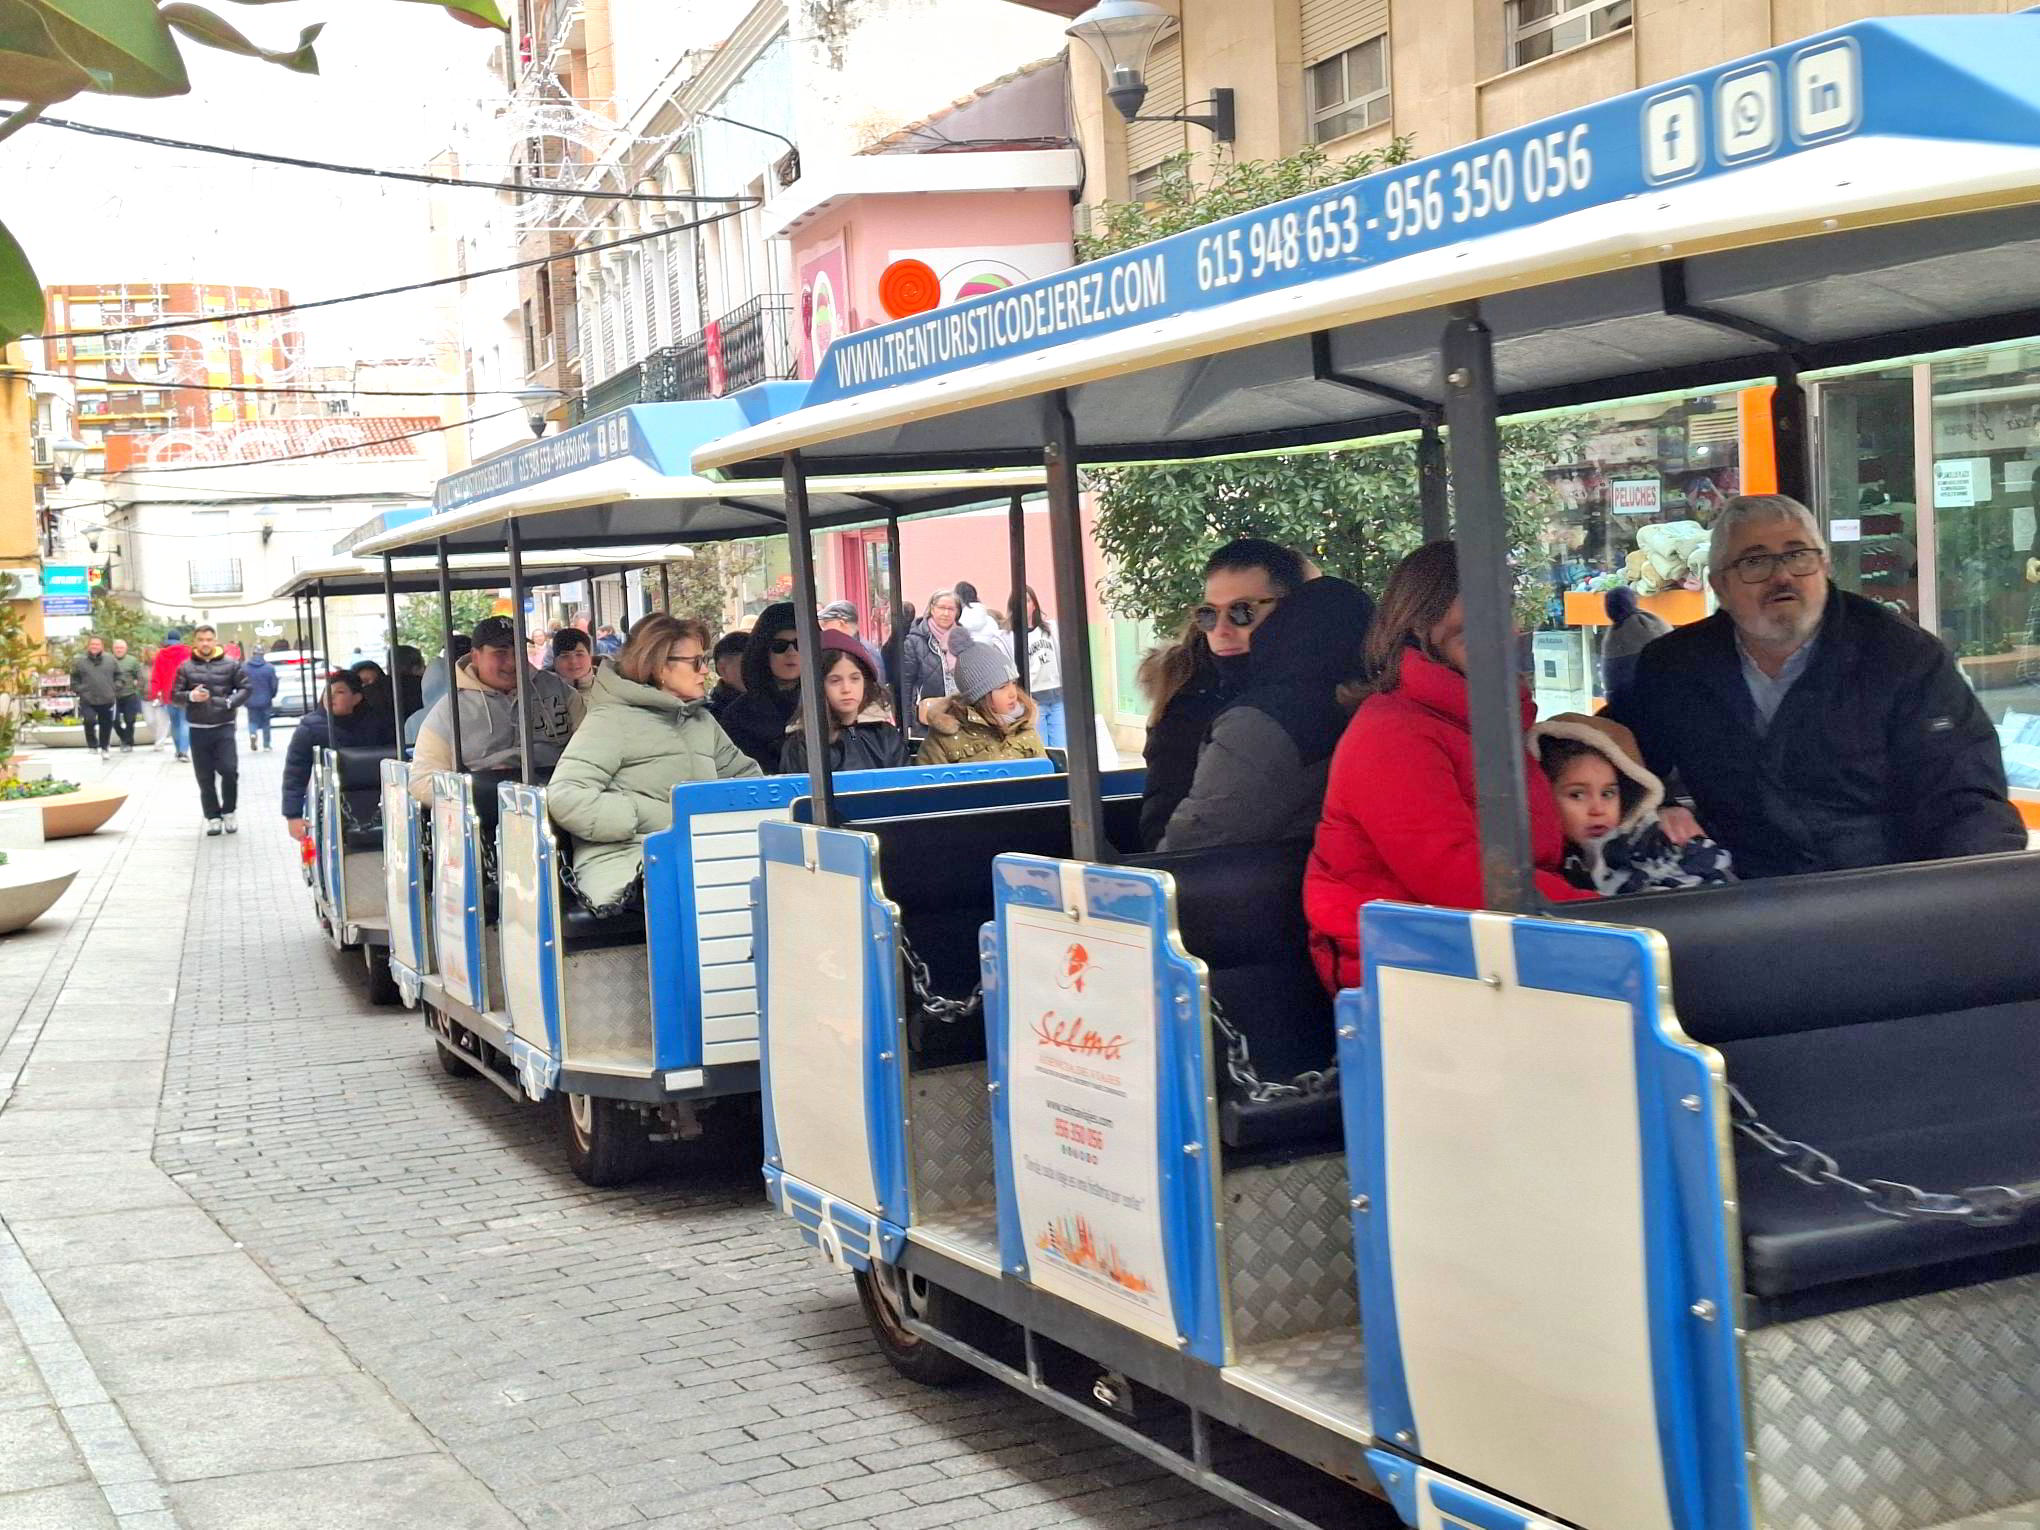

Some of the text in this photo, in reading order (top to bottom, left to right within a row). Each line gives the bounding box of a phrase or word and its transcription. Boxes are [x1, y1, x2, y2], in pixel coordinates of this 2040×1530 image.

[834, 253, 1166, 390] WWW.TRENTURISTICODEJEREZ.COM
[1197, 229, 1244, 291] 615
[1248, 212, 1300, 278] 948
[1306, 195, 1359, 263] 653
[1384, 168, 1444, 242] 956
[1451, 146, 1515, 225] 350
[1523, 122, 1593, 204] 056
[1614, 486, 1657, 508] PELUCHES
[1037, 1009, 1123, 1061] Selma
